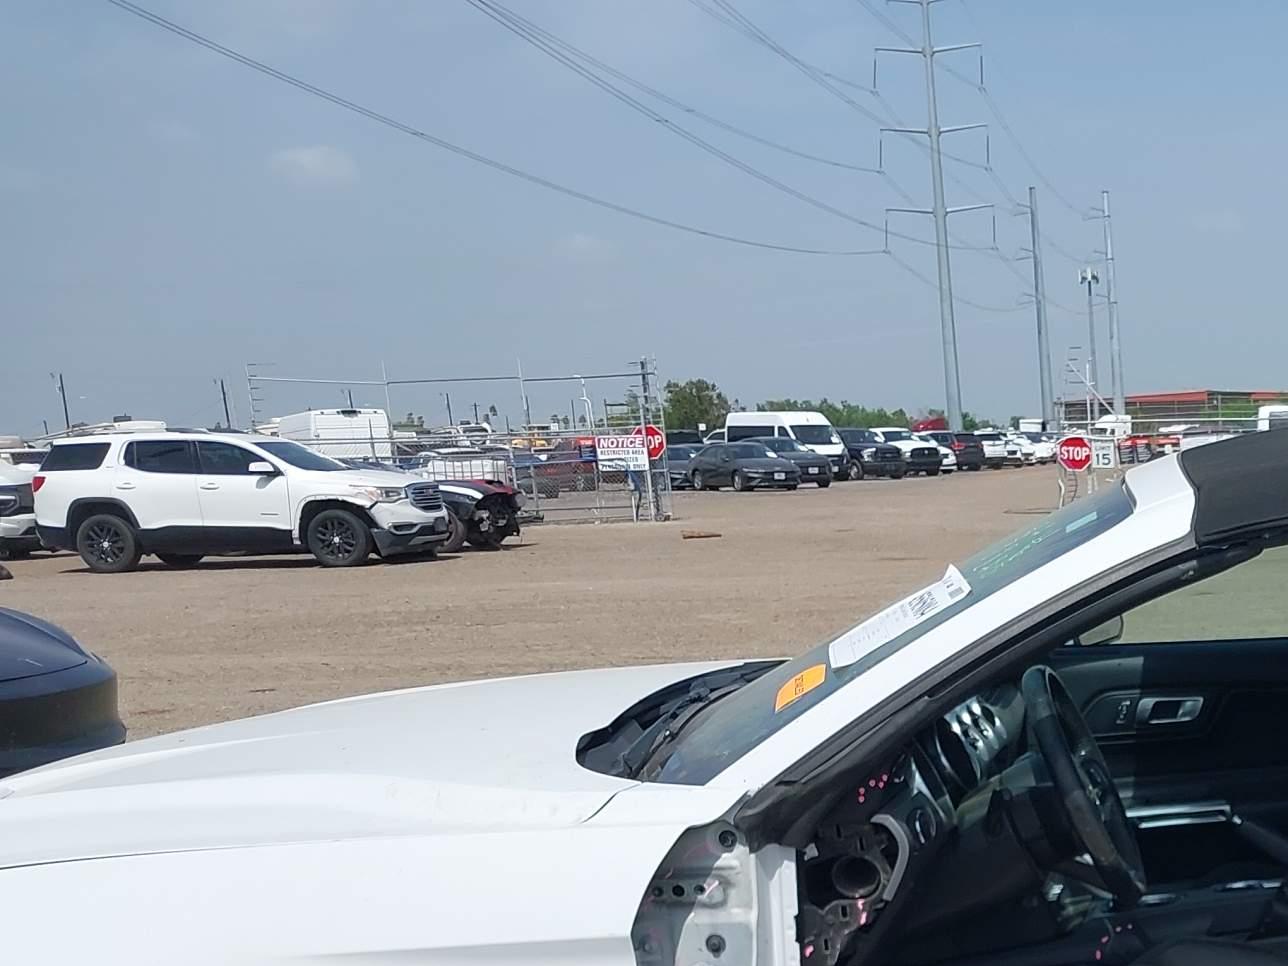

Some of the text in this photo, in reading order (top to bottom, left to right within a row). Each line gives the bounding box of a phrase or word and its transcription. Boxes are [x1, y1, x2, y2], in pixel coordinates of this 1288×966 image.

[600, 438, 643, 448] NOTICE
[647, 435, 662, 448] OP
[1060, 446, 1090, 461] STOP
[1096, 453, 1111, 466] 15
